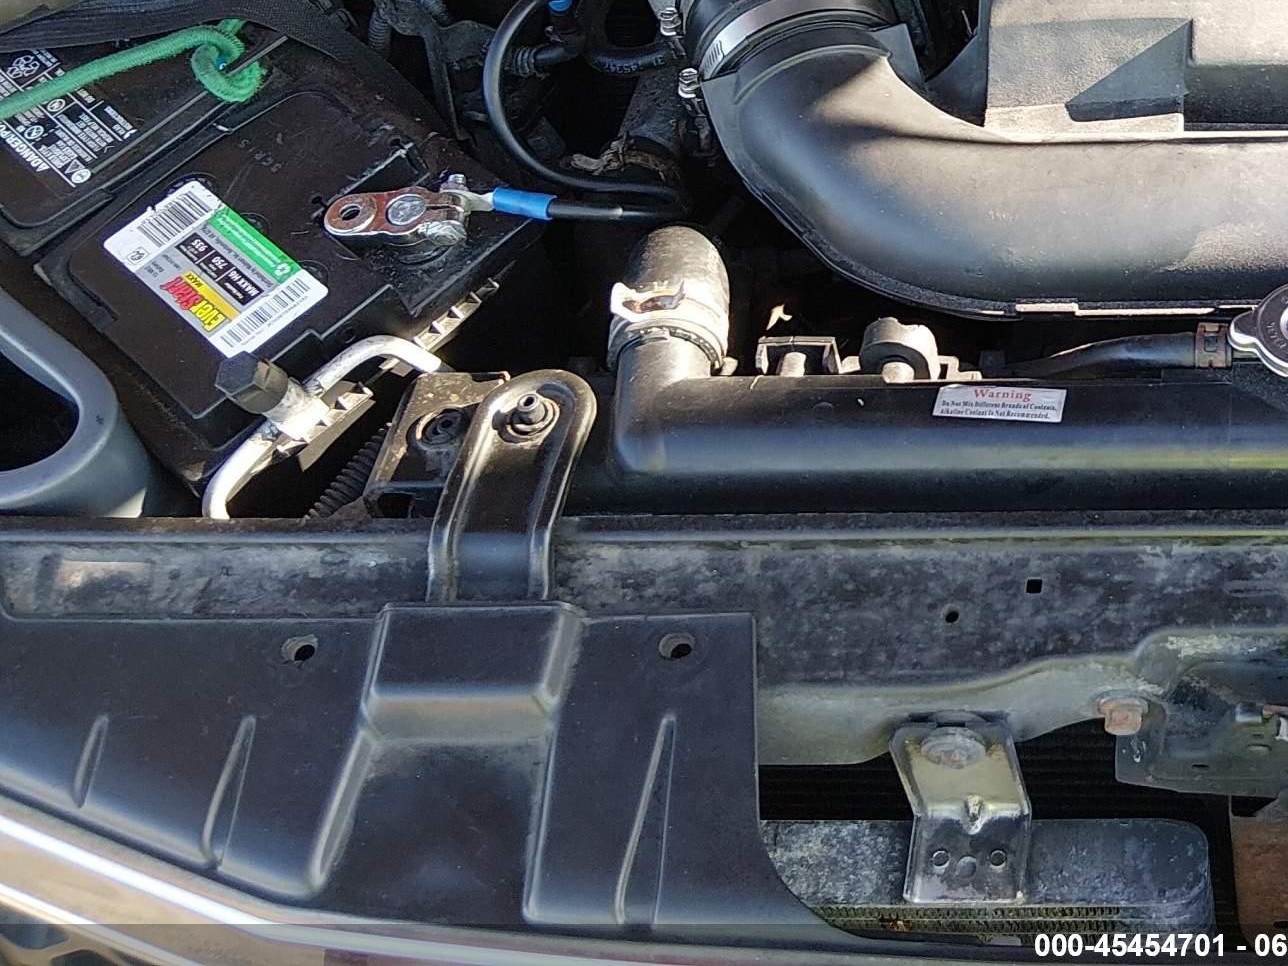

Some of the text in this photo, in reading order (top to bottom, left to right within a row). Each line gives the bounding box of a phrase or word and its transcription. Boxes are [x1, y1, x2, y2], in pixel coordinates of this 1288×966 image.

[190, 238, 208, 252] 935
[211, 255, 228, 269] 750
[227, 269, 260, 296] MAXX H6
[157, 272, 227, 333] EverStart
[974, 389, 1032, 402] Warning
